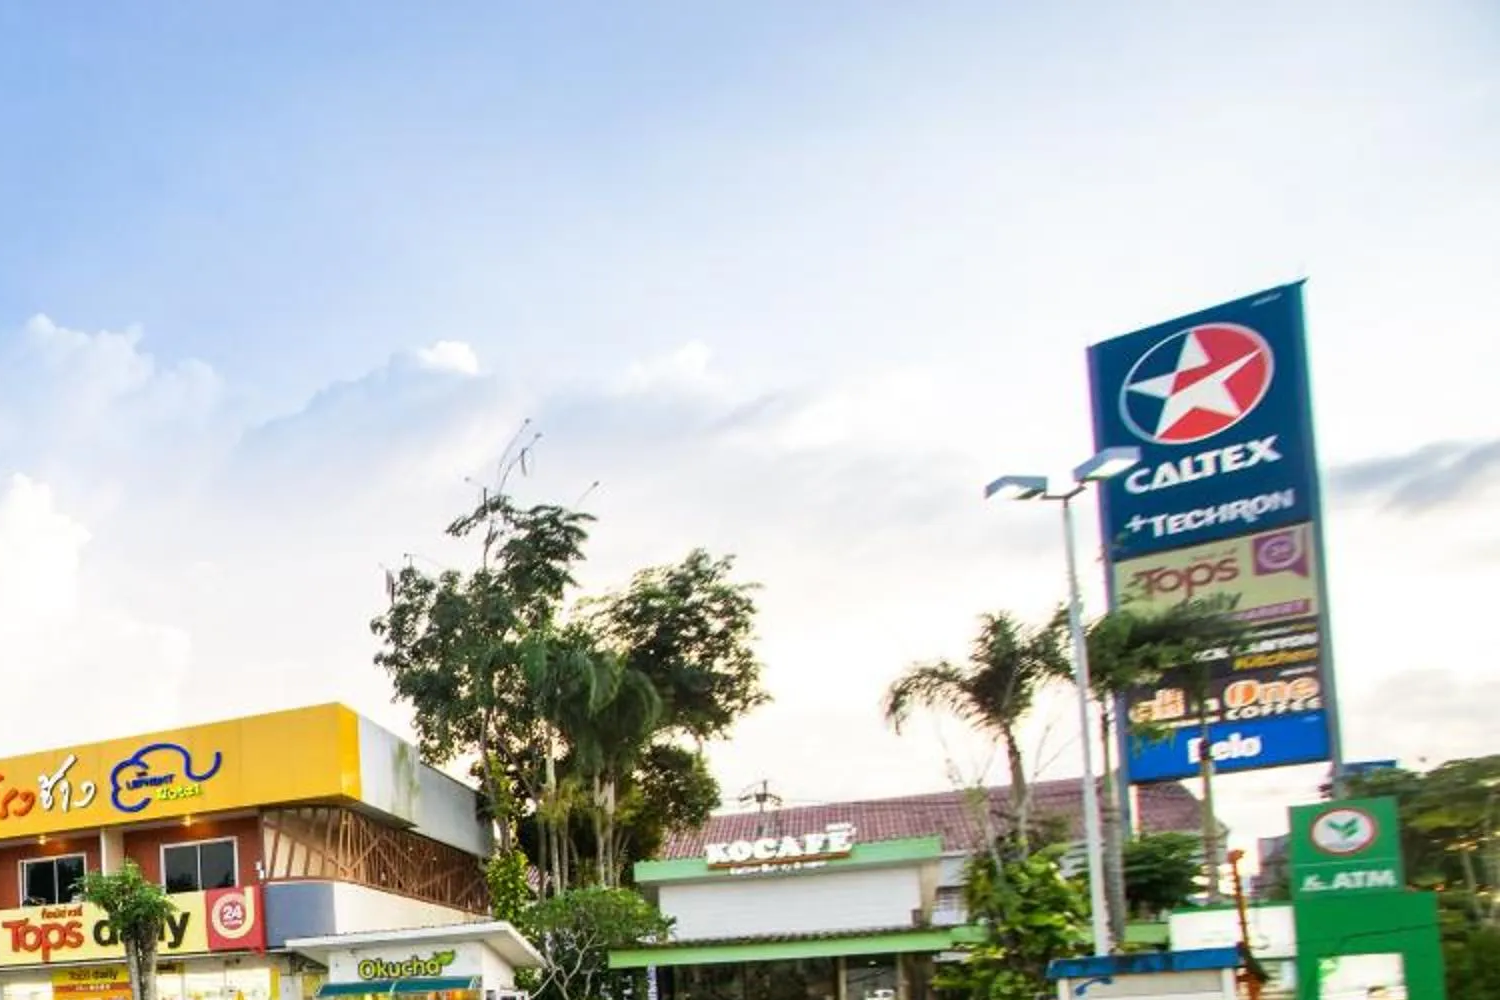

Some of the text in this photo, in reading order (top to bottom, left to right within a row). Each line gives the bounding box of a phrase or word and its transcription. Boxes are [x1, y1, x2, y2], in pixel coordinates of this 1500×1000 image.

[1124, 434, 1283, 494] CALTEX
[1133, 556, 1241, 599] Tops
[2, 916, 85, 963] Tops
